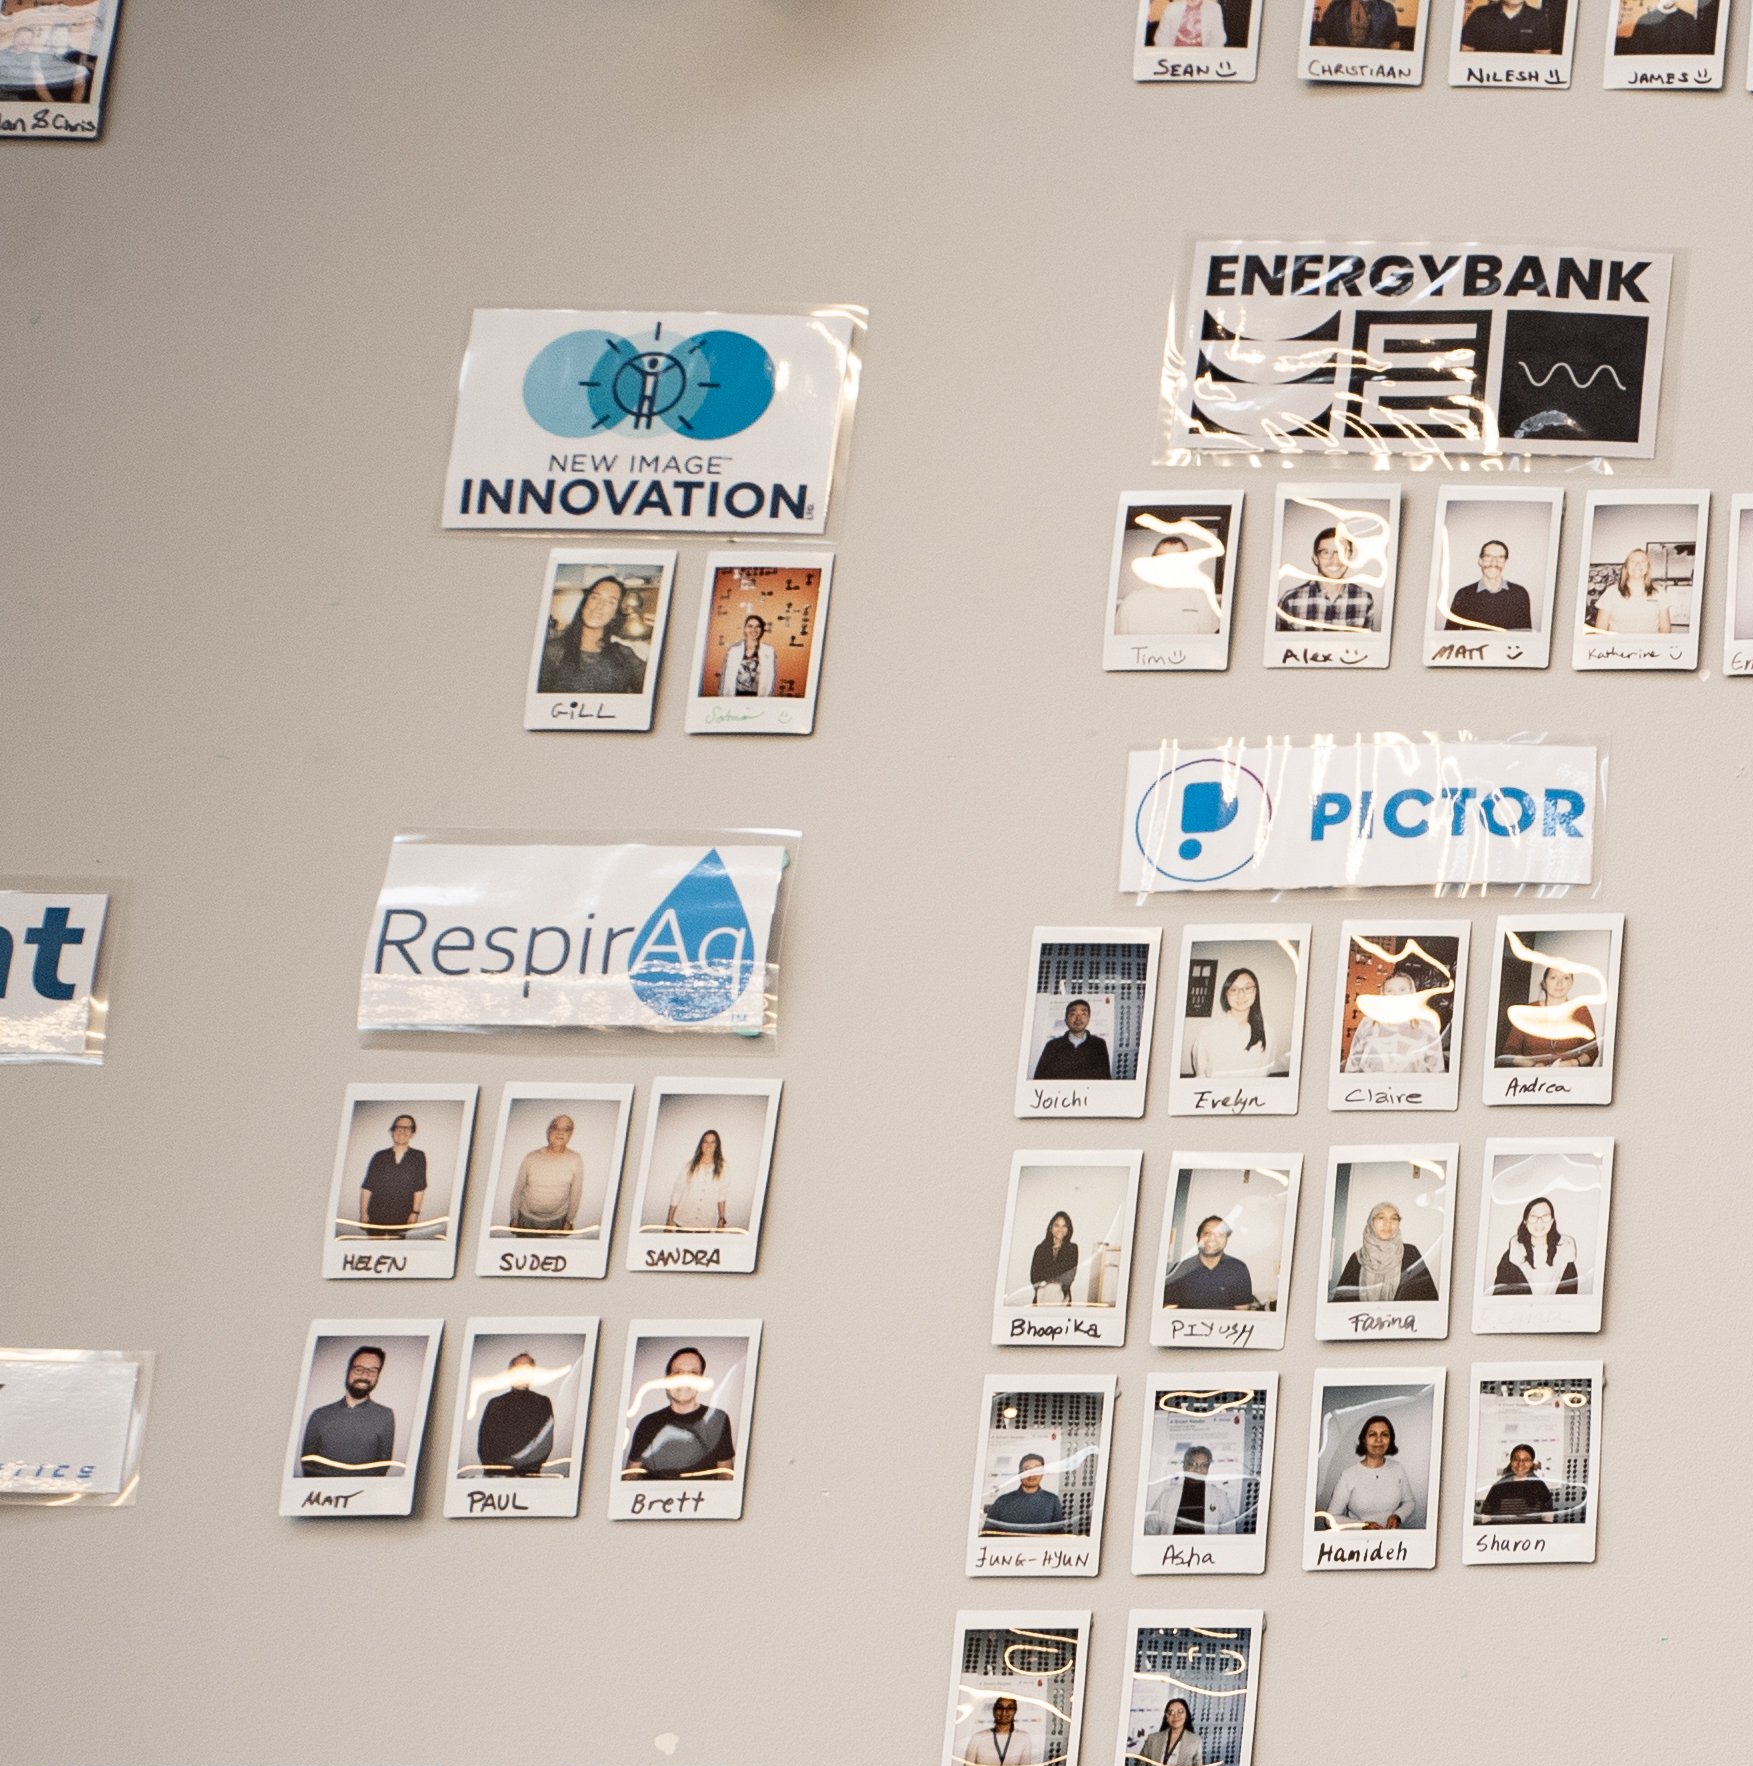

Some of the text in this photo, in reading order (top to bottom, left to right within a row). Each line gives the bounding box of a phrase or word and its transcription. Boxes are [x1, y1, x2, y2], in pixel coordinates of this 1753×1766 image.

[1154, 58, 1211, 79] SEAN
[1465, 66, 1541, 85] NILESH
[1627, 68, 1694, 86] JAMES
[1204, 253, 1654, 304] ENERGYBANK
[548, 453, 723, 477] NEW IMAGE
[458, 477, 808, 521] INNOVATION
[1282, 647, 1337, 666] Alex
[1430, 644, 1489, 662] MATT
[1310, 788, 1586, 843] PICTOR
[1193, 1090, 1266, 1113] Evelyn
[1344, 1087, 1423, 1106] Claire
[342, 1253, 408, 1273] HELEN
[499, 1253, 567, 1273] SUDED
[644, 1247, 722, 1267] SANDRA
[300, 1489, 364, 1509] MATT
[467, 1490, 530, 1513] PAUL
[631, 1492, 706, 1514] Brett
[1317, 1540, 1408, 1565] Hamideh
[1475, 1533, 1547, 1555] Sharon
[1162, 1547, 1216, 1569] Asha
